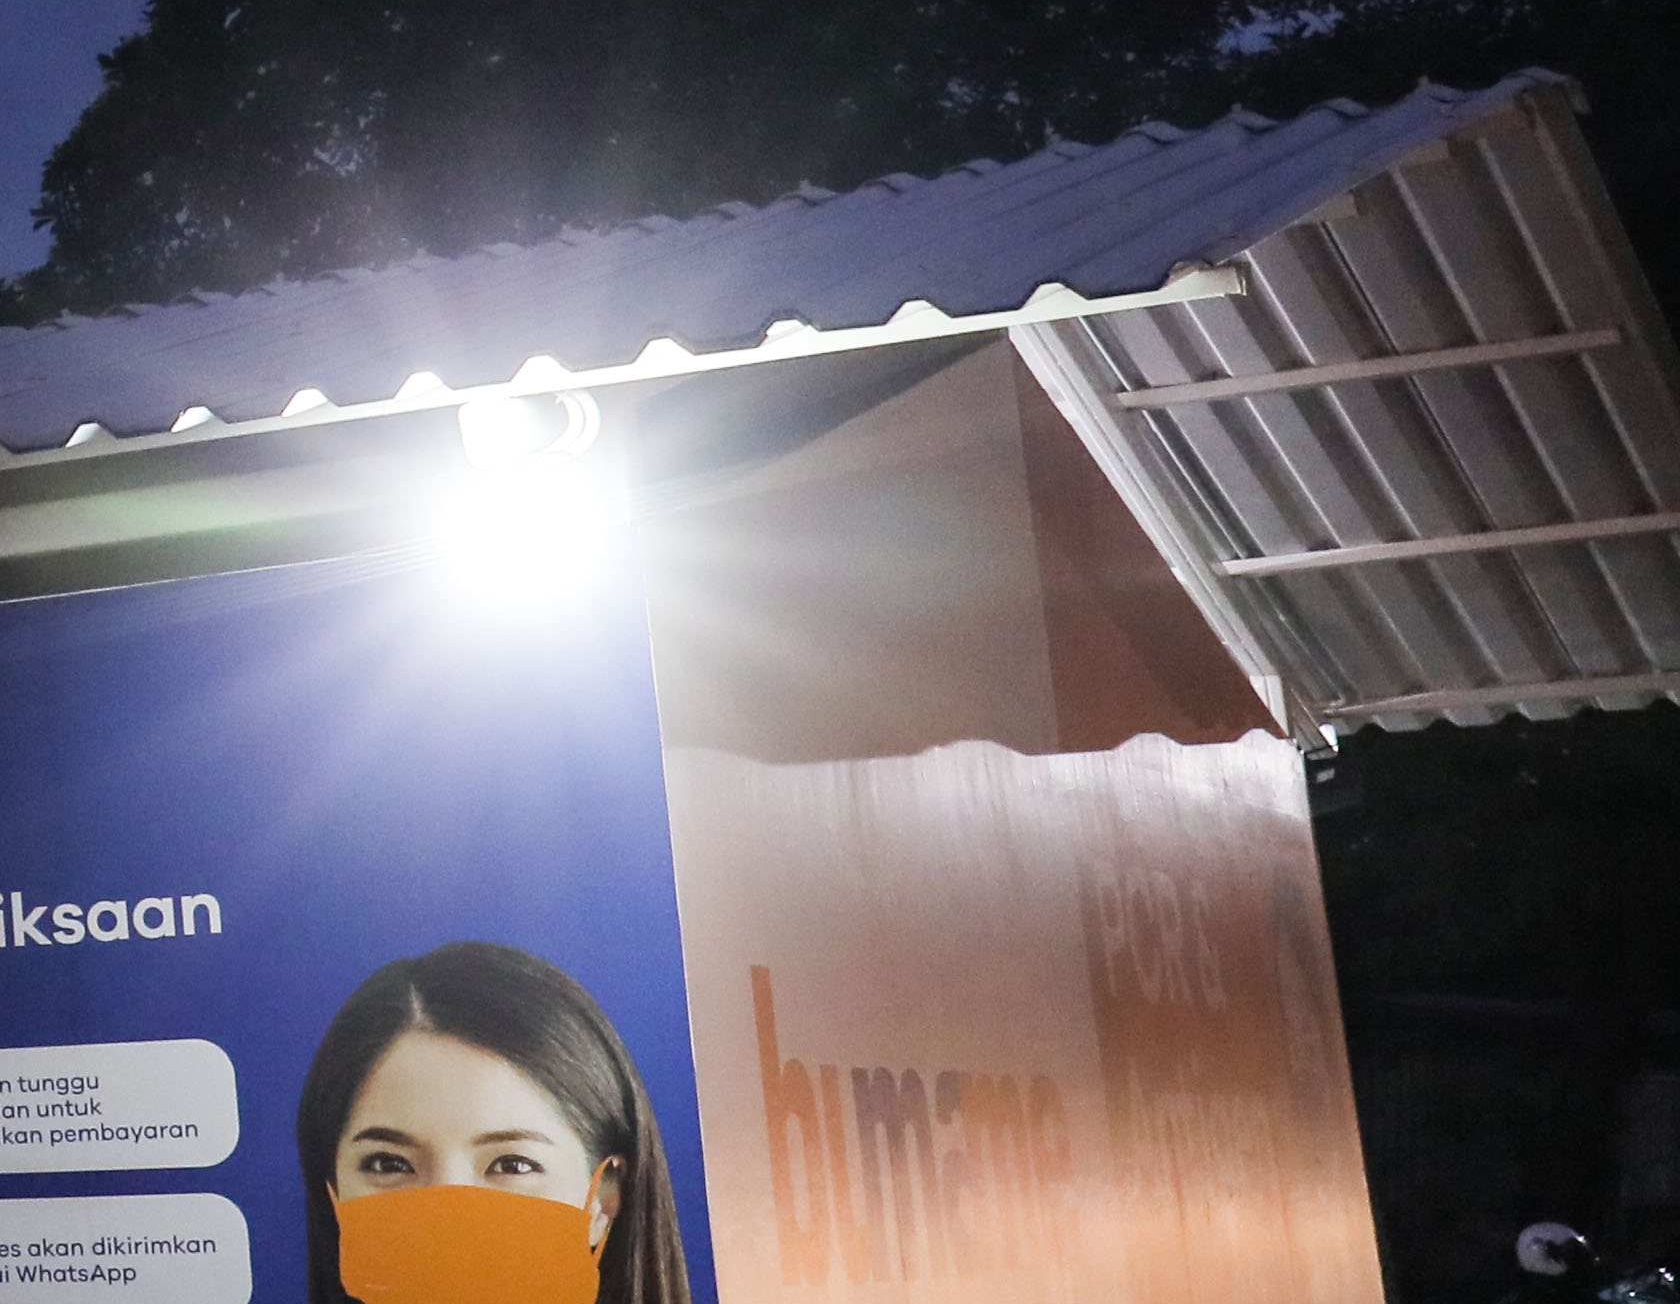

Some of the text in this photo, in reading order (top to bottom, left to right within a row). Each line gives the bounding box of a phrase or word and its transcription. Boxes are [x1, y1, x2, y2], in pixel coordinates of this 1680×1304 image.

[17, 1074, 100, 1095] tunggu
[36, 1098, 102, 1119] untuk
[50, 1122, 199, 1146] pembayaran
[750, 965, 1073, 1285] bumame
[27, 1238, 84, 1257] akan
[92, 1236, 217, 1256] dikirimkan
[16, 1263, 137, 1286] WhatsApp
